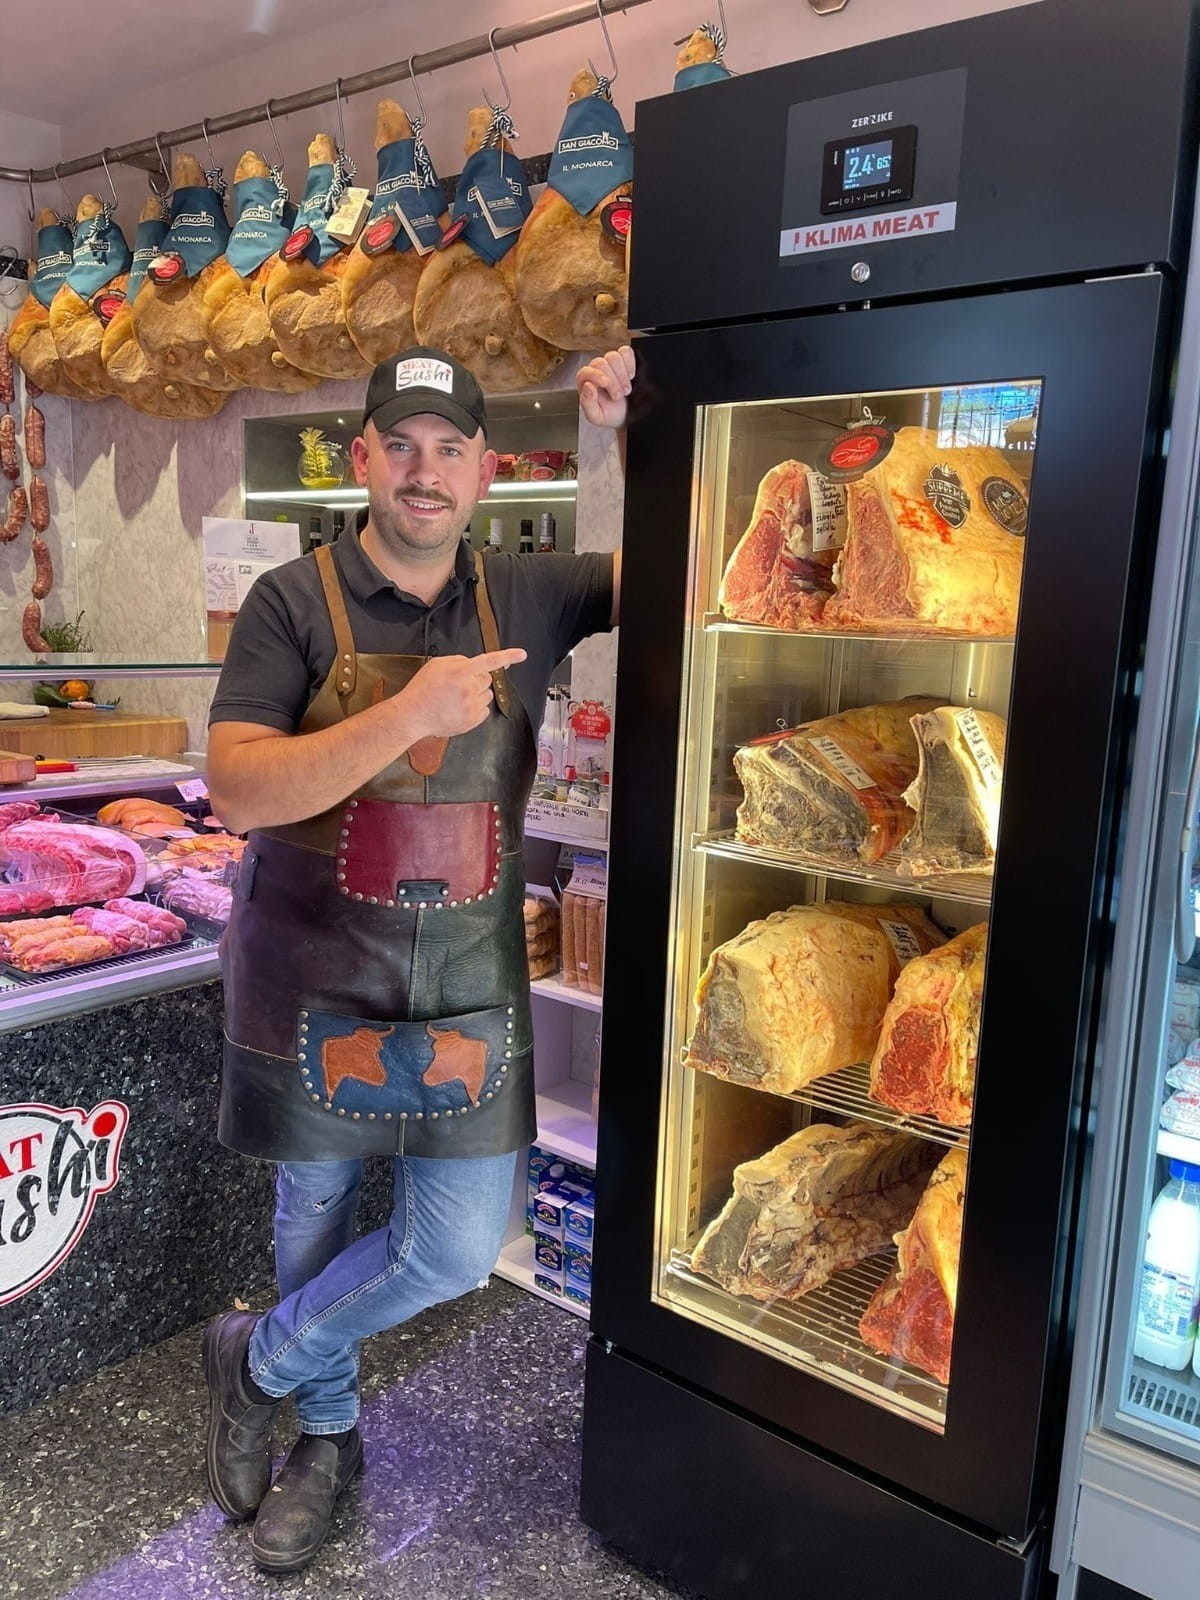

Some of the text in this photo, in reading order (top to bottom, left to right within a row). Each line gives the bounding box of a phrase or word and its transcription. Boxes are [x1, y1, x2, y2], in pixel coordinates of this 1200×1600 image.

[561, 138, 616, 150] SAN GIACOMO
[571, 160, 614, 170] MONARCA
[848, 154, 874, 178] 2.4
[378, 183, 390, 193] SAN
[805, 211, 940, 248] KLIMA MEAT
[402, 361, 434, 371] MEAT
[398, 364, 452, 387] Sushi
